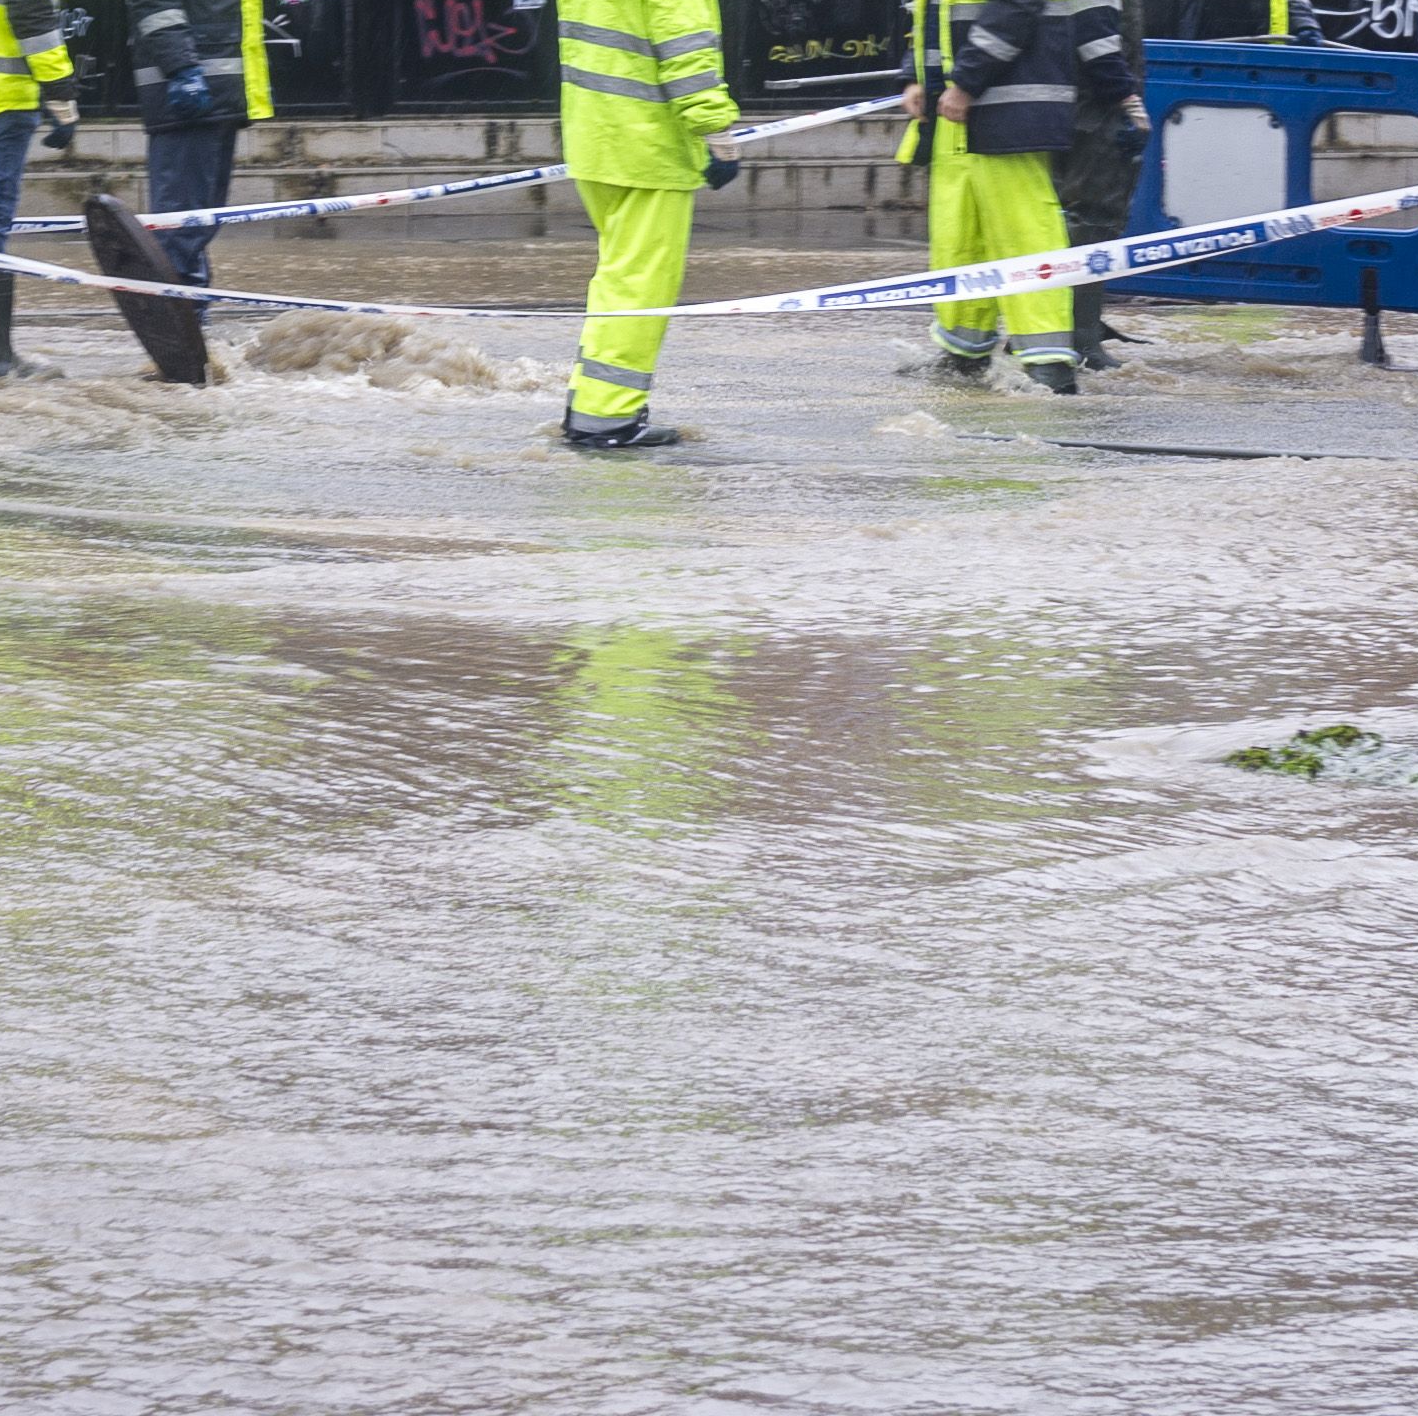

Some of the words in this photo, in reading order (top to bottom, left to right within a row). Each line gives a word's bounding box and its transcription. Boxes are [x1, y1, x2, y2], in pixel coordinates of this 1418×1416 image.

[1132, 244, 1173, 263] 092
[1173, 229, 1257, 257] POLIZIA
[864, 282, 947, 303] POLIZIA
